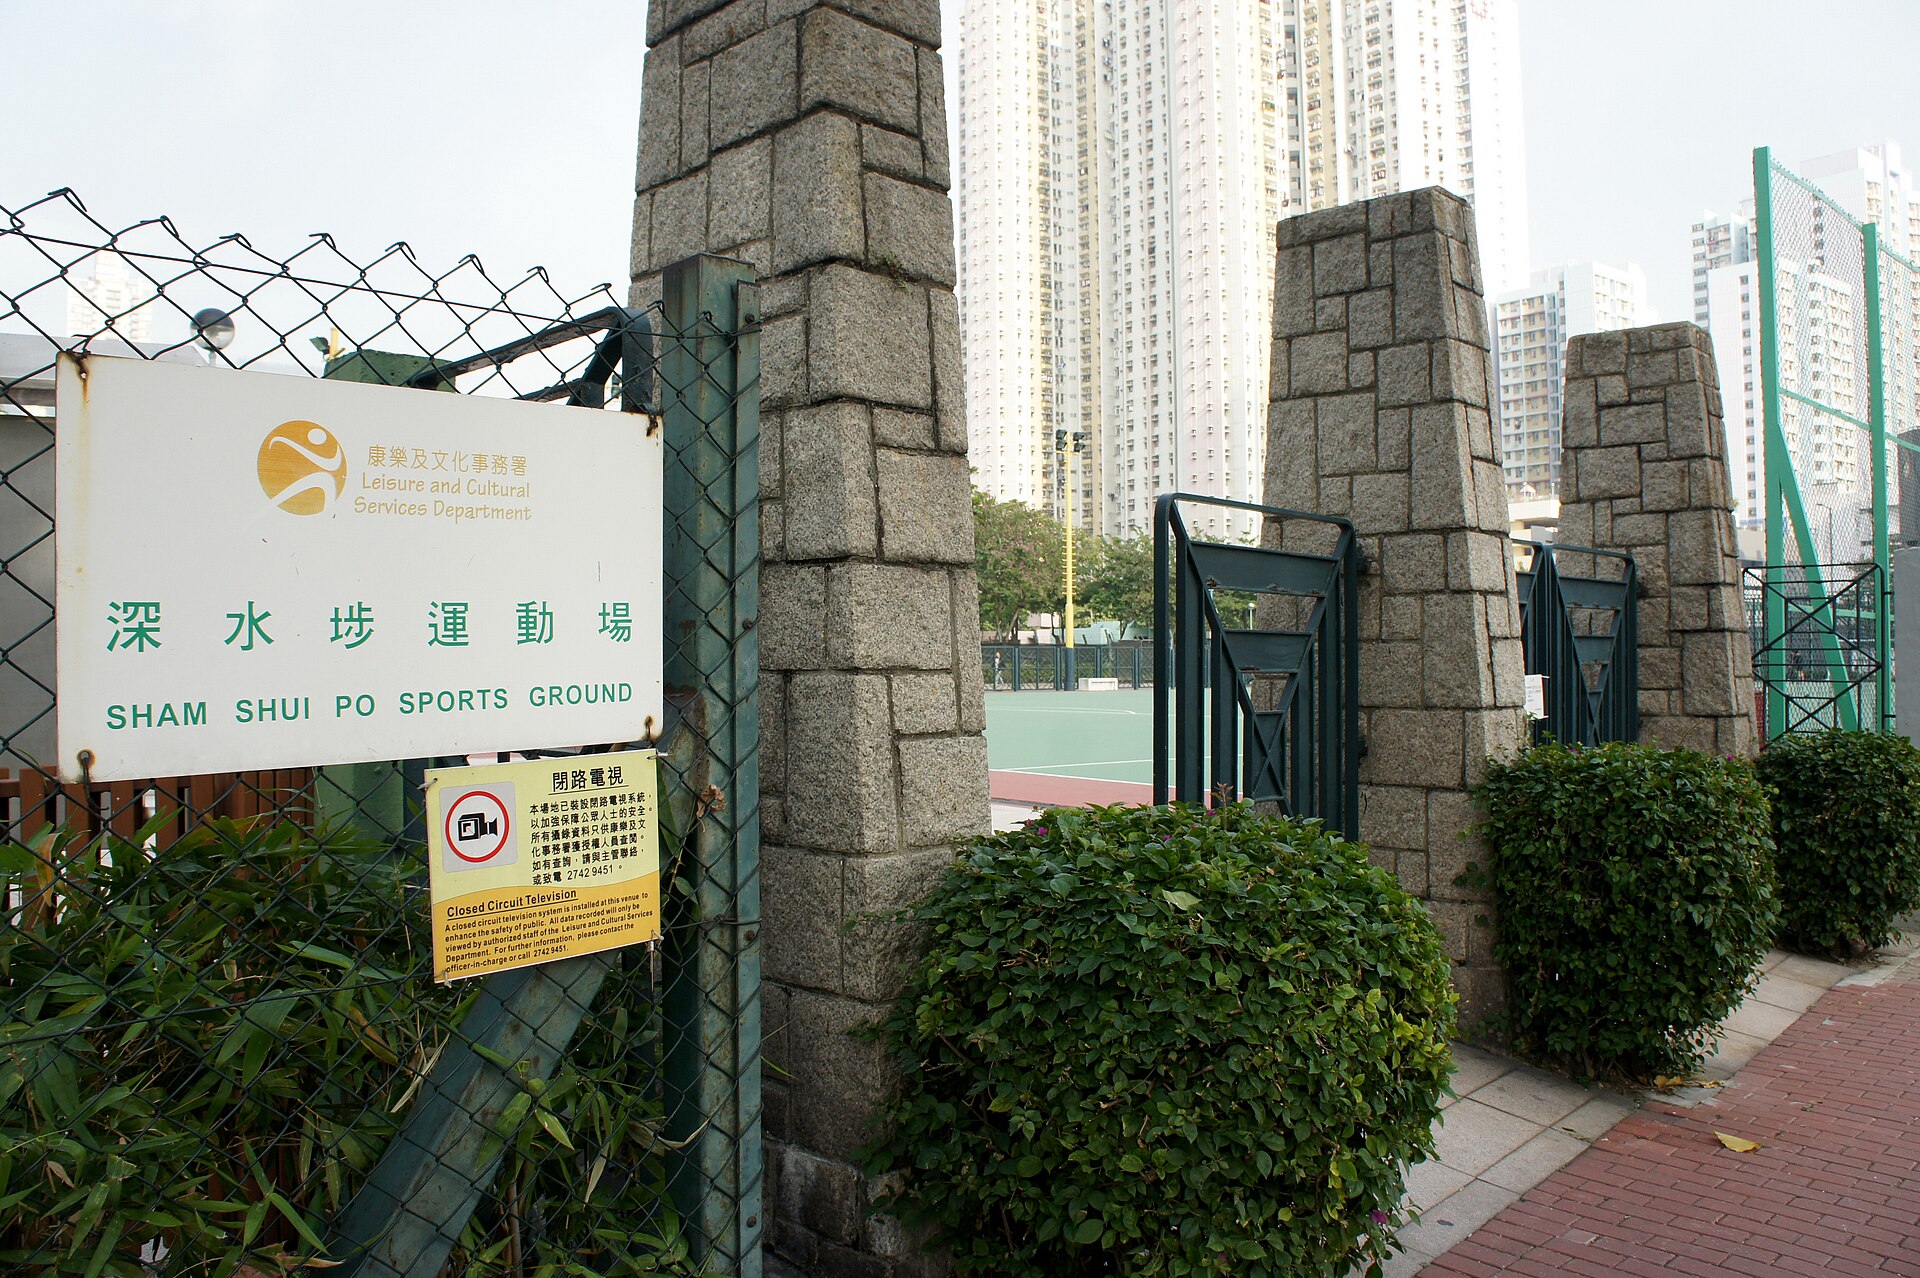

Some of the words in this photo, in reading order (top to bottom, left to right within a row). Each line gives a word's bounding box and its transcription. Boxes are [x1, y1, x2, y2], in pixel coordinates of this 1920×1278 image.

[367, 444, 528, 477] 康樂及文化事務署
[362, 471, 425, 493] Leisure
[430, 478, 461, 494] and
[466, 478, 531, 498] Cultural
[354, 496, 428, 516] Services
[433, 499, 532, 525] Department
[106, 600, 633, 653] 深水埗運動場
[106, 701, 207, 730] SHAM
[235, 697, 310, 723] SHUI
[335, 694, 376, 718] PO
[399, 687, 508, 715] SPORTS
[529, 682, 633, 707] GROUND
[552, 766, 624, 792] 閉路電視
[567, 868, 590, 880] 2742
[445, 924, 451, 932] A
[451, 920, 476, 930] closed
[478, 917, 502, 926] circuit
[502, 911, 537, 923] television
[538, 907, 562, 918] system
[564, 905, 570, 913] is
[571, 900, 600, 911] installed
[607, 896, 620, 905] this
[621, 894, 639, 902] venue
[447, 902, 485, 917] Closed
[487, 896, 523, 911] Circuit
[525, 890, 576, 905] Television
[445, 931, 477, 942] enhance
[478, 929, 490, 937] the
[491, 925, 513, 935] safety
[514, 923, 521, 931] of
[523, 920, 547, 931] public.
[549, 917, 559, 925] All
[560, 915, 575, 923] data
[575, 909, 605, 920] recorded
[606, 906, 617, 915] will
[618, 904, 631, 913] only
[445, 942, 472, 952] viewed
[473, 940, 482, 949] by
[483, 933, 522, 946] authorized
[523, 929, 539, 939] staff
[540, 928, 547, 936] of
[548, 927, 559, 935] the
[561, 921, 587, 932] Leisure
[587, 919, 600, 927] and
[600, 913, 626, 925] Cultural
[627, 910, 653, 920] Services
[446, 949, 491, 962] Department.
[494, 946, 507, 954] For
[507, 941, 532, 952] further
[533, 934, 575, 947] information,
[577, 930, 599, 941] please
[600, 925, 624, 935] contact
[624, 922, 634, 930] the
[446, 956, 508, 972] officer-in-charge
[517, 951, 531, 960] call
[533, 948, 550, 957] 2742
